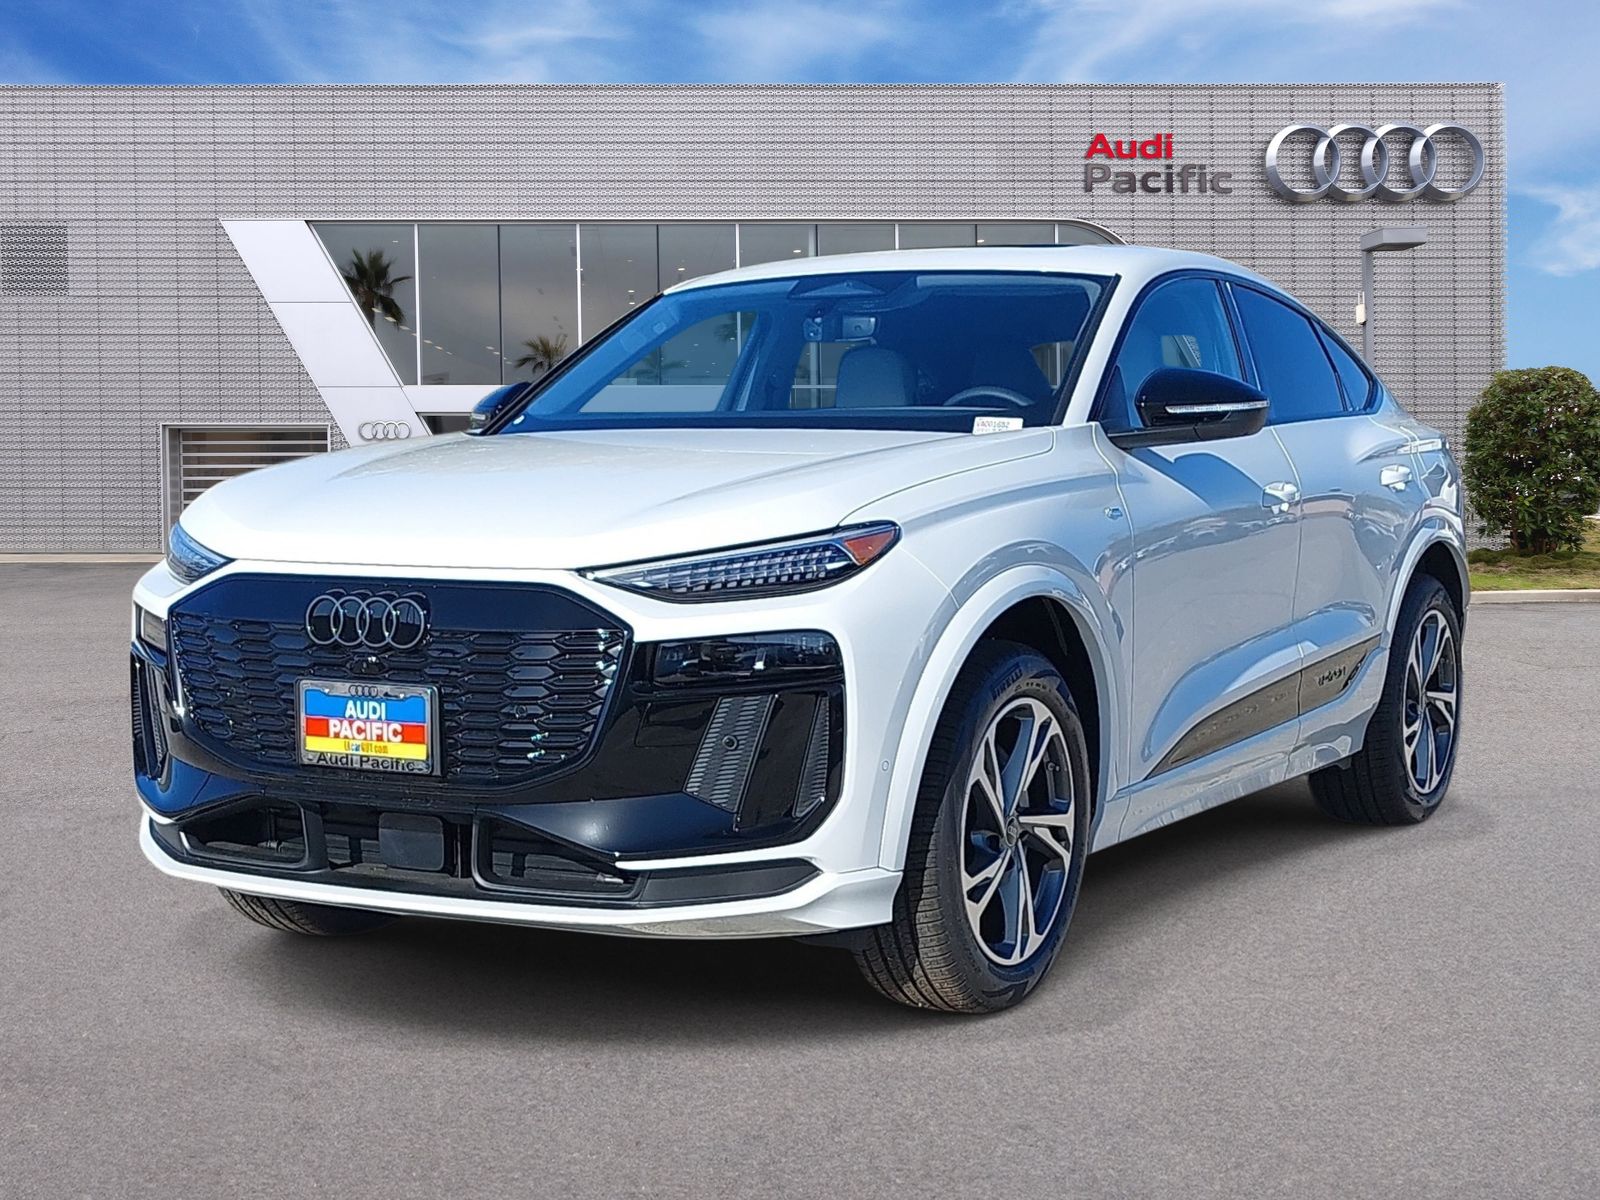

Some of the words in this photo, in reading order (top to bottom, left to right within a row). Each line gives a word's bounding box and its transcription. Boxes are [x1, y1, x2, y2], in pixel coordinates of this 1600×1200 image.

[1084, 133, 1173, 160] Audi
[1084, 163, 1233, 194] Pacific
[344, 699, 387, 721] AUDI
[328, 719, 403, 743] PACIFIC
[316, 752, 354, 765] Audi
[359, 755, 416, 772] Pacific
